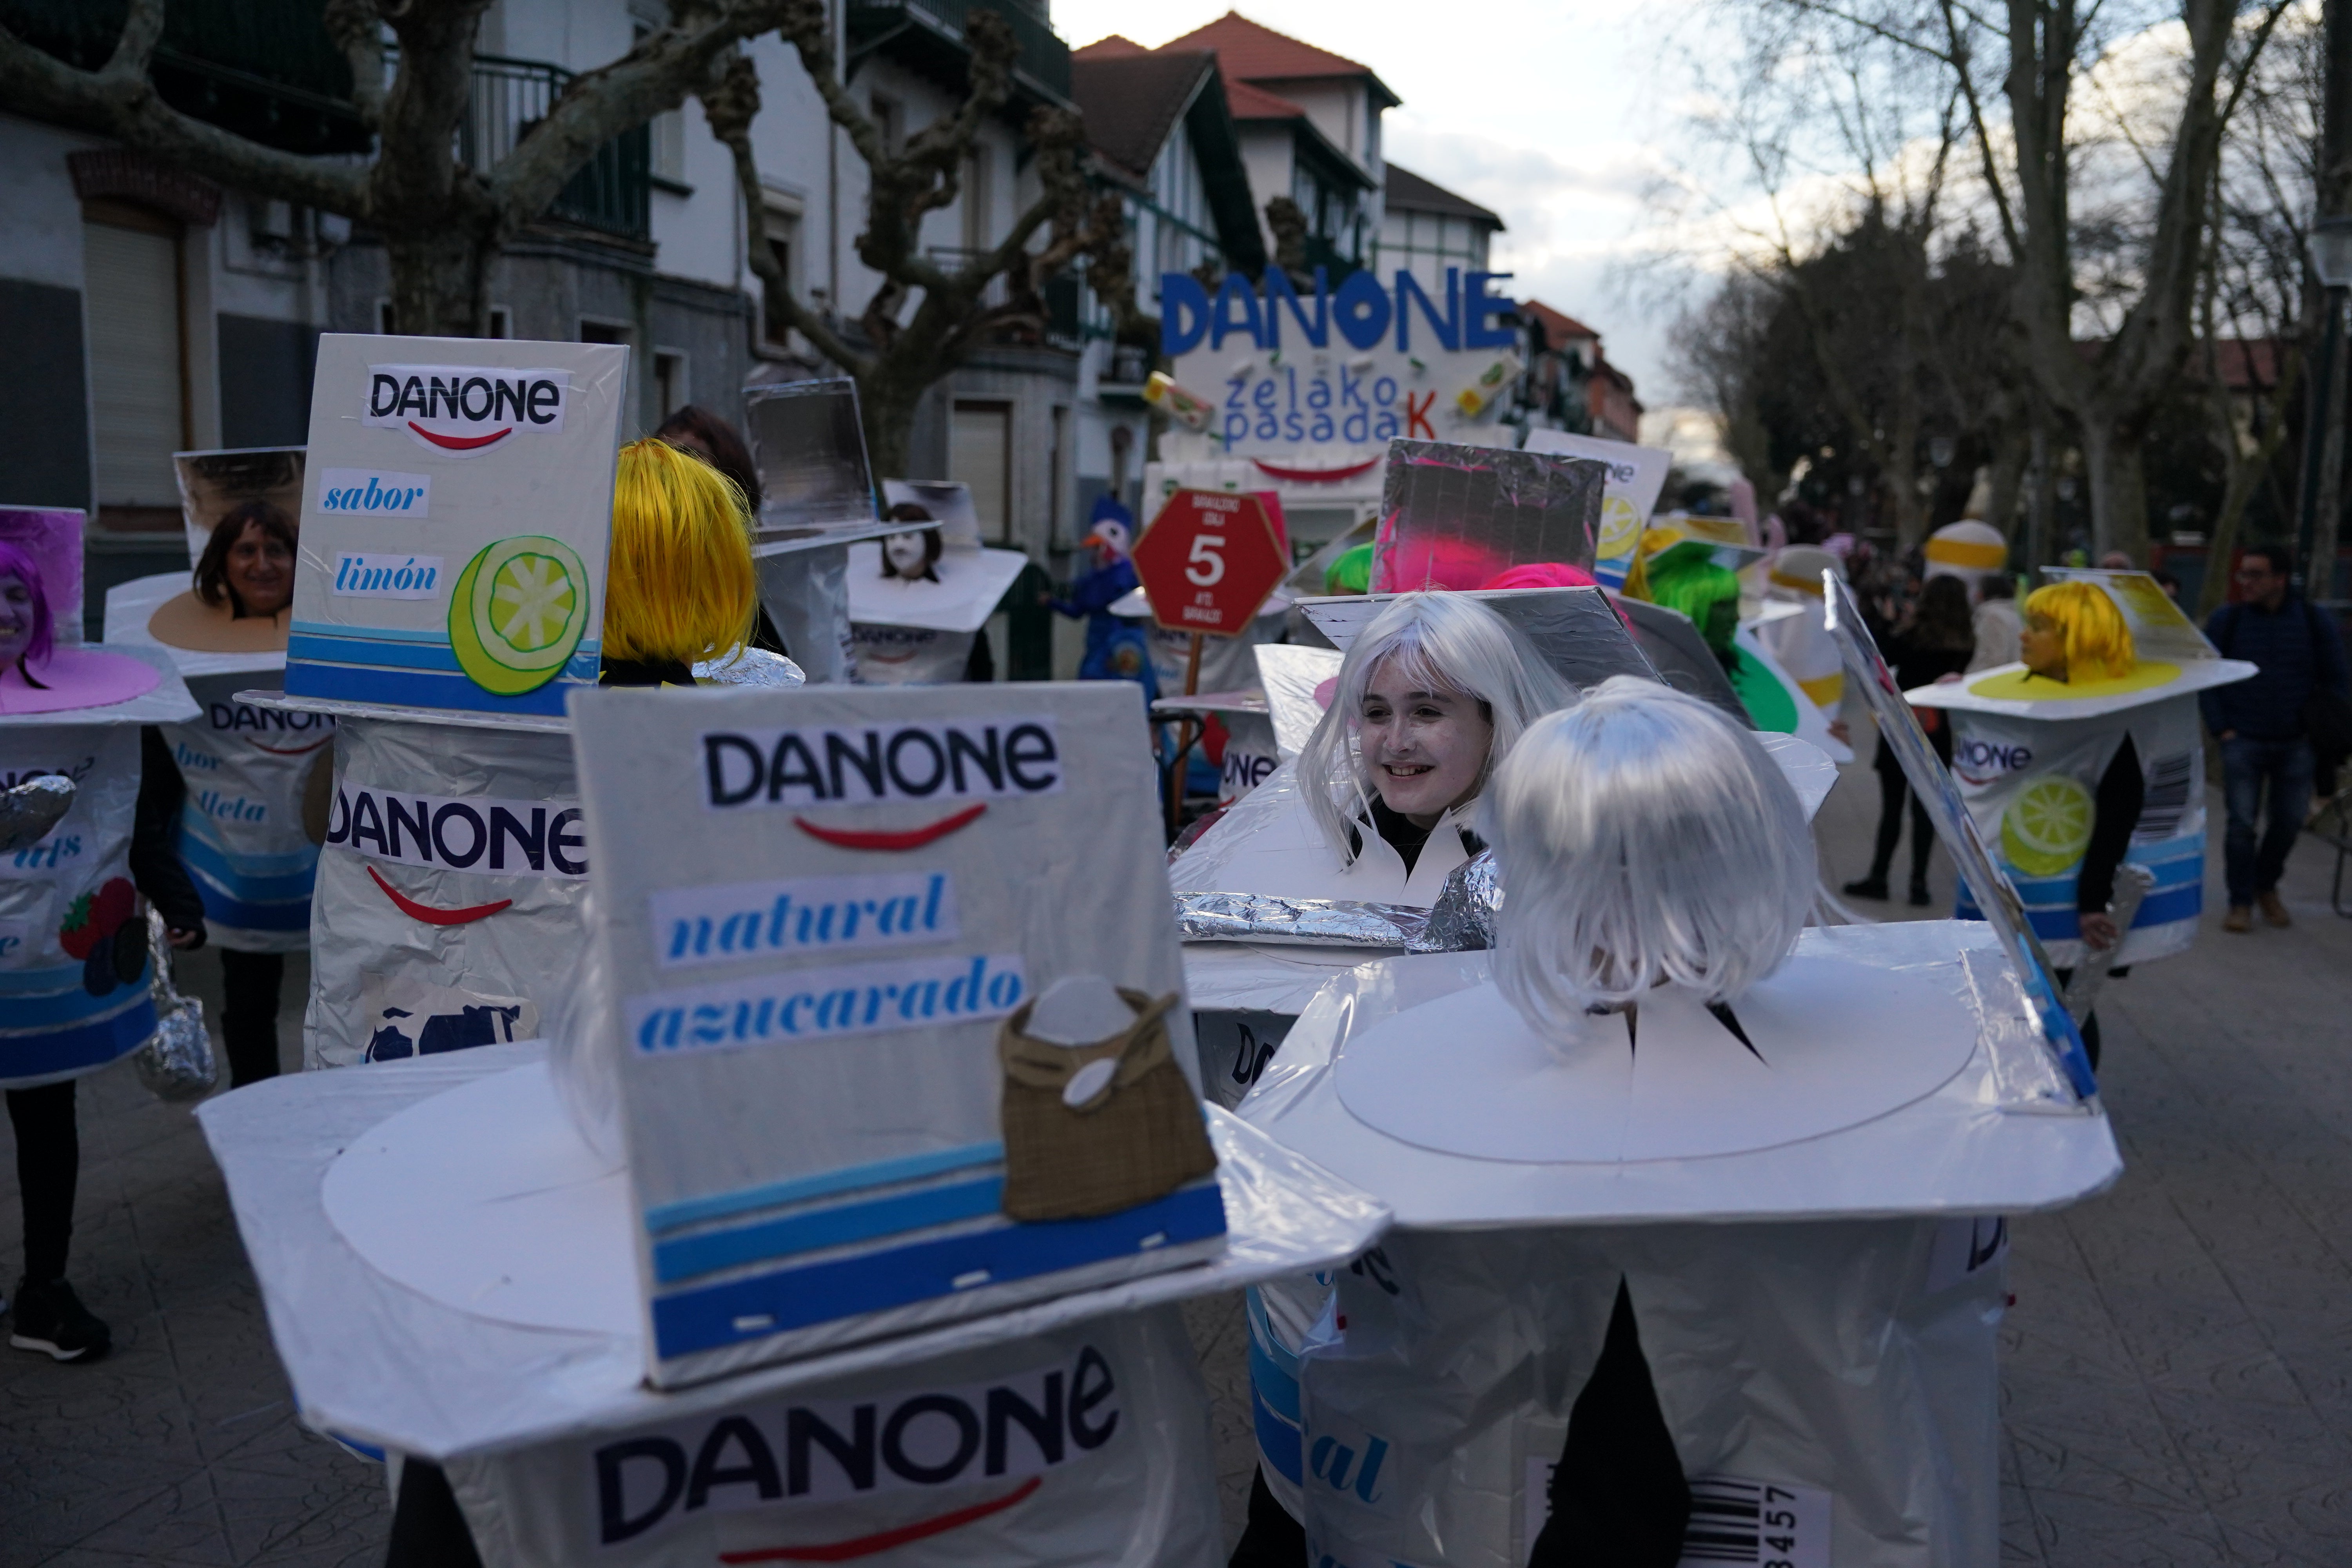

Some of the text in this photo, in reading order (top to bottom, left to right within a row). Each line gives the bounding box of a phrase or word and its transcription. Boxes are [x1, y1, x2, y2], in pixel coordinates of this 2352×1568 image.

[1161, 266, 1515, 356] DANONE
[323, 477, 424, 510] sabor
[336, 558, 437, 591] limón
[1185, 533, 1226, 587] 5
[211, 703, 336, 731] DANON
[666, 873, 946, 961] natural
[637, 958, 1024, 1054] azucarado
